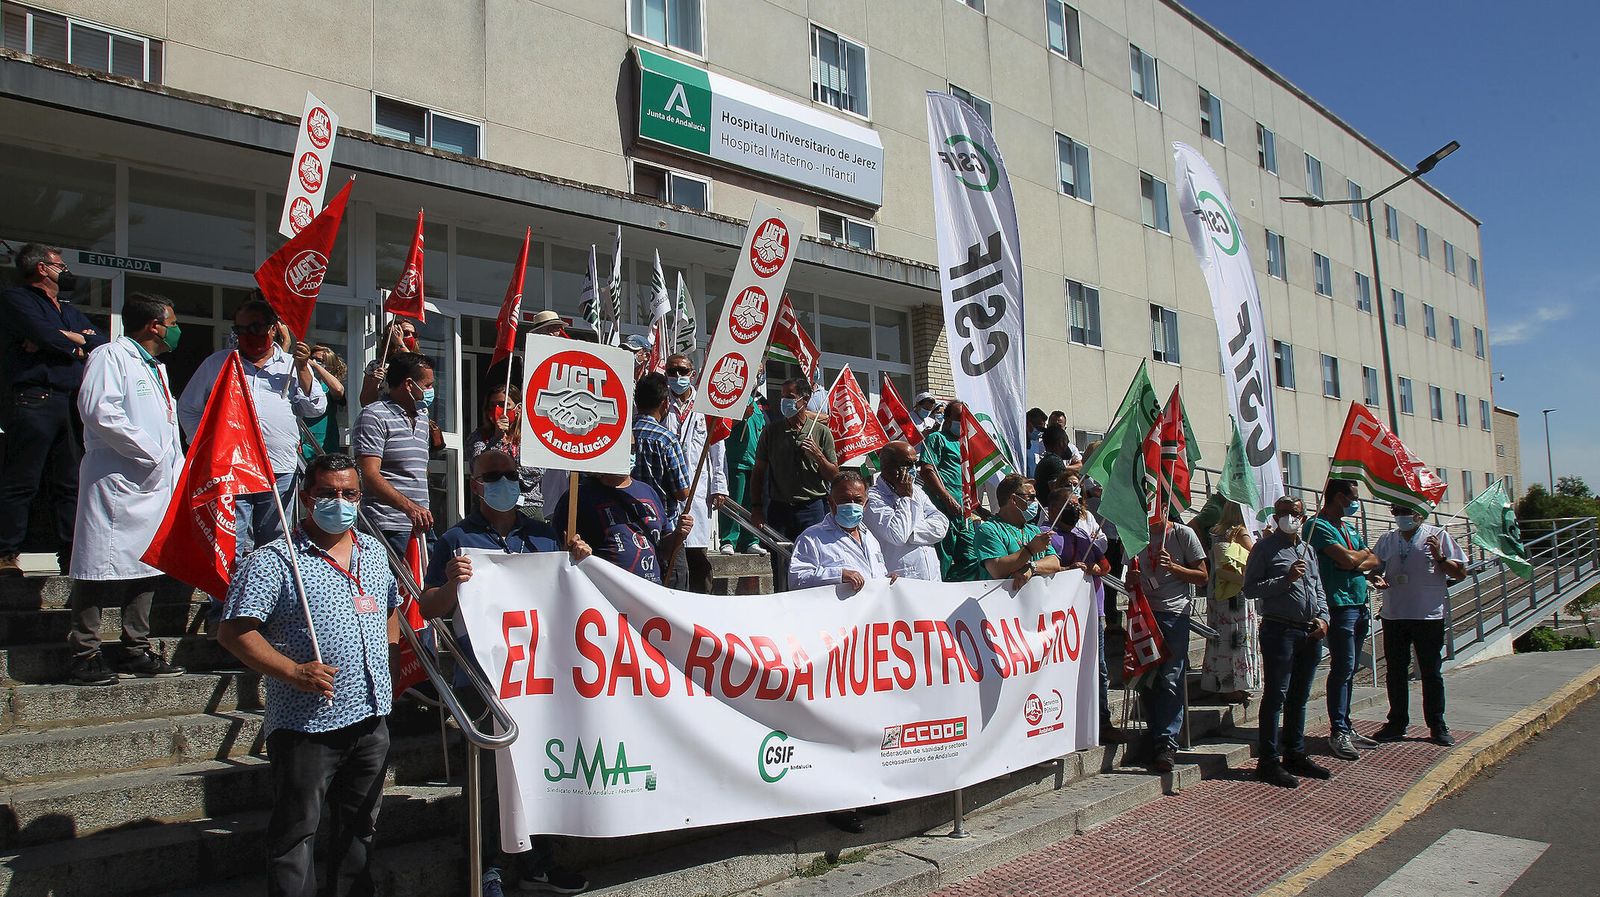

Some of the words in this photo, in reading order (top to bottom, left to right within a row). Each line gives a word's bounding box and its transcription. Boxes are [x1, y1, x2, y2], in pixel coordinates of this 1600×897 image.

[313, 108, 329, 127] UGT
[646, 109, 666, 120] Junta
[666, 114, 675, 123] de
[721, 111, 768, 136] Hospital
[770, 126, 836, 157] Universitario
[838, 150, 850, 162] de
[851, 153, 877, 170] Jerez
[304, 153, 321, 173] UGT
[721, 133, 768, 158] Hospital
[770, 148, 814, 171] Materno
[822, 163, 856, 184] Infantil
[295, 198, 312, 215] UGT
[762, 221, 787, 246] UGT
[88, 254, 152, 271] ENTRADA
[288, 253, 323, 286] UGT
[740, 289, 766, 312] UGT
[720, 356, 745, 377] UGT
[549, 362, 608, 396] UGT
[541, 429, 612, 454] Andalucía
[499, 609, 554, 700] EL
[571, 607, 672, 698] SAS
[684, 623, 814, 702] ROBA
[821, 619, 984, 699] NUESTRO
[1026, 698, 1041, 711] UGT
[903, 723, 955, 743] CCOO
[765, 745, 795, 765] CSIF
[880, 747, 912, 758] federación
[922, 743, 944, 753] sanidad
[948, 741, 968, 750] sectores
[543, 736, 651, 790] SMA
[881, 756, 927, 767] sociosanitarios
